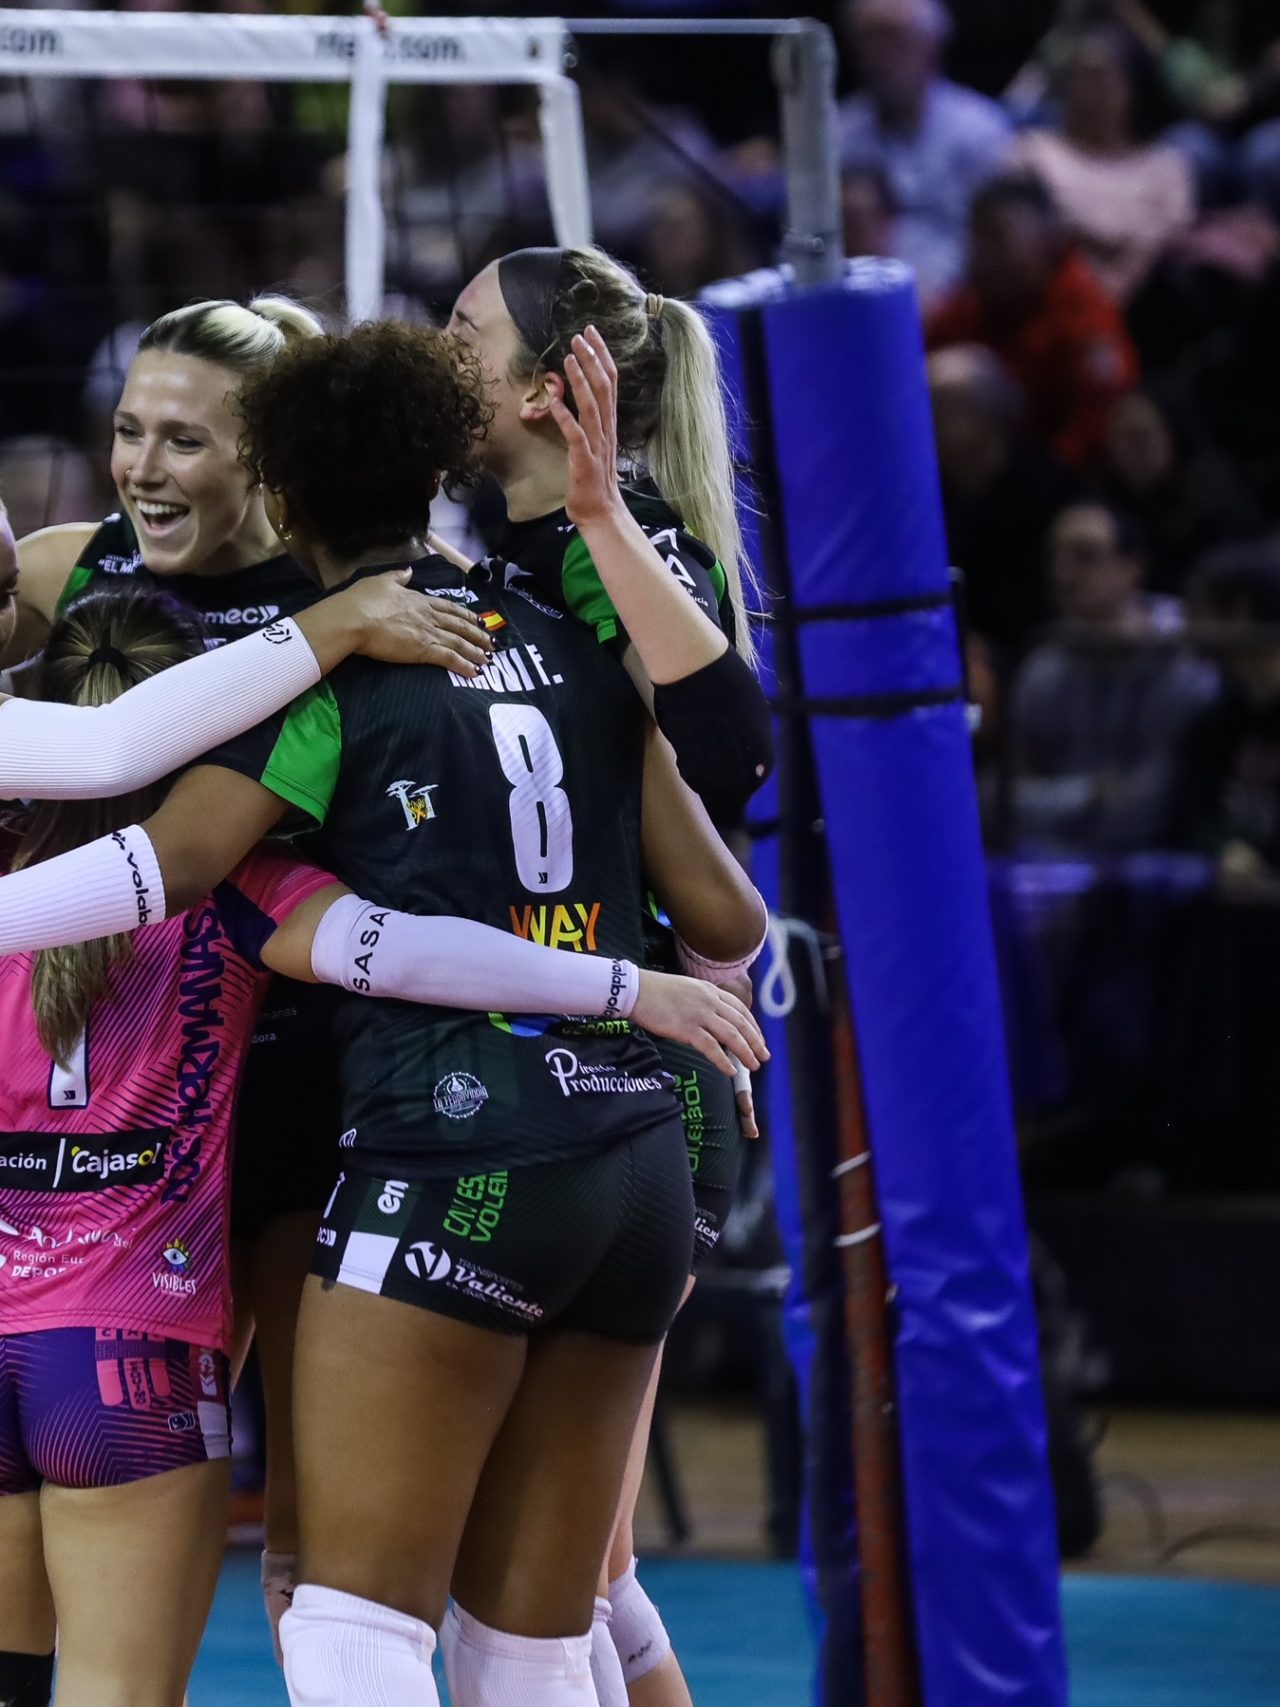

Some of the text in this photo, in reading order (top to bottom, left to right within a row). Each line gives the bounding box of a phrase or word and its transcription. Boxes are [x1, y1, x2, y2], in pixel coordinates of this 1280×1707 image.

[489, 703, 573, 893] 8
[509, 902, 601, 952] WAY
[71, 1142, 162, 1180] Cajasol
[13, 1250, 56, 1265] Región
[152, 1271, 198, 1295] VISIBLES
[453, 1264, 545, 1318] Valiente
